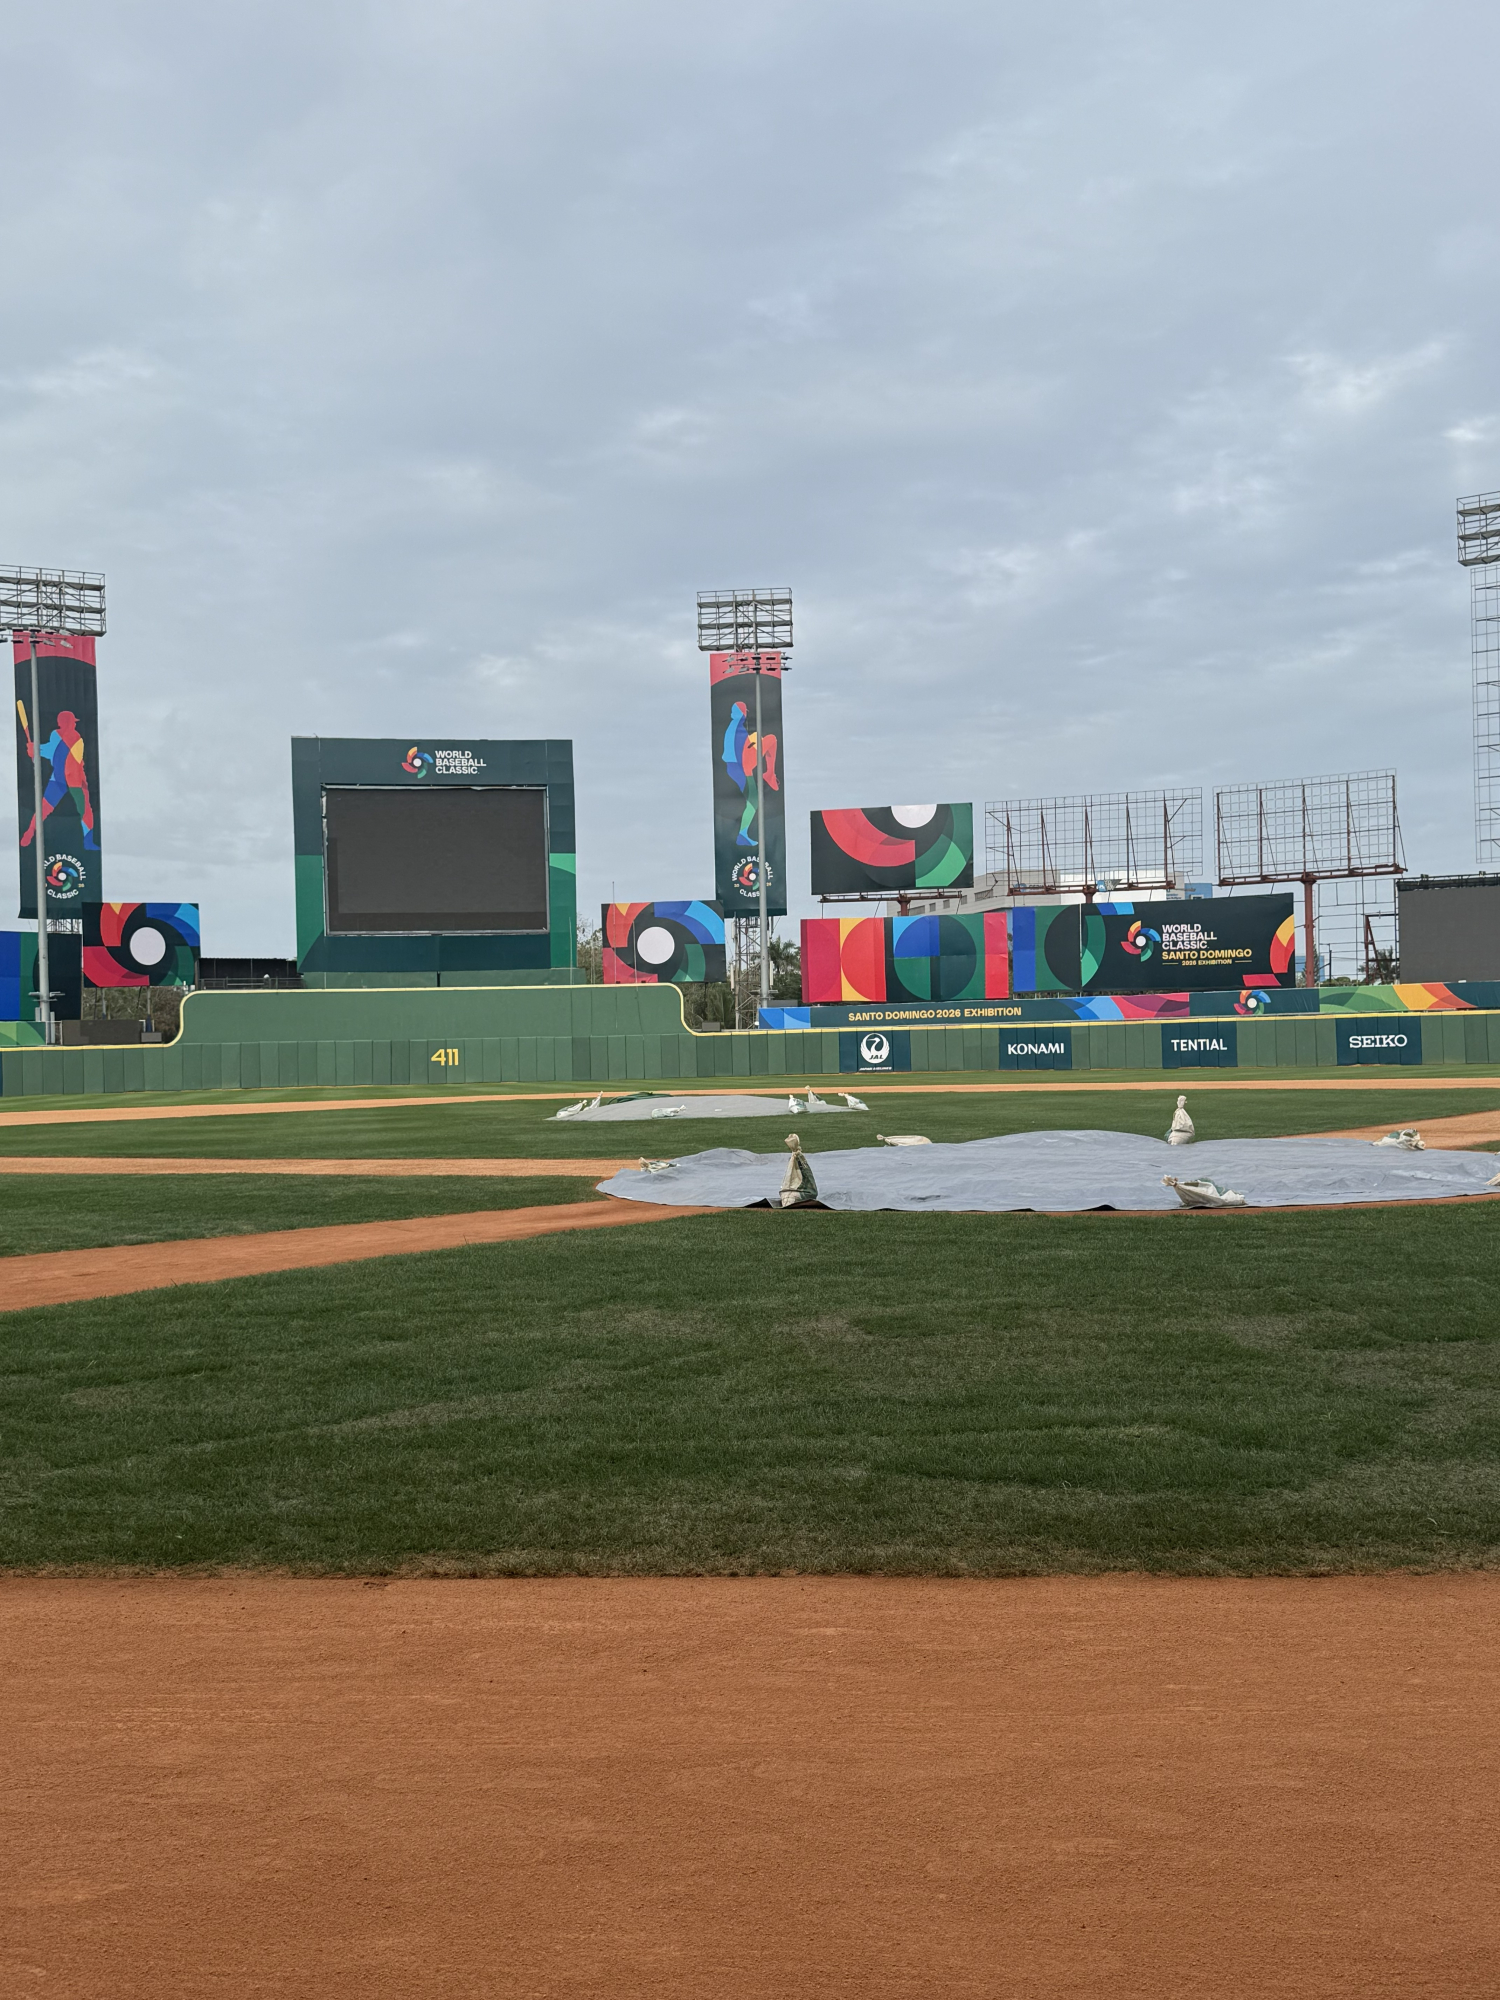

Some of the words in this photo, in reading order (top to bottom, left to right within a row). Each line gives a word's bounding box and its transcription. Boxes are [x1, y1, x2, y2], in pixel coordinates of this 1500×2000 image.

[435, 750, 472, 758] WORLD
[435, 766, 478, 774] CLASSIC
[55, 854, 86, 880] BASEBALL
[732, 858, 746, 881] WORLD
[47, 889, 79, 899] CLASSIC
[1162, 924, 1201, 933] WORLD
[1162, 931, 1217, 941] BASEBALL
[1162, 941, 1207, 949] CLASSIC
[1162, 950, 1198, 960] SANTO
[1200, 949, 1252, 959] DOMINGO
[848, 1011, 883, 1021] SANTO
[885, 1010, 935, 1020] DOMINGO
[936, 1008, 961, 1018] 2026
[964, 1007, 1021, 1017] EXHIBITION
[1171, 1039, 1227, 1051] TENTIAL
[1349, 1034, 1407, 1048] SEIKO
[1008, 1043, 1064, 1055] KONAMI
[430, 1048, 459, 1066] 411
